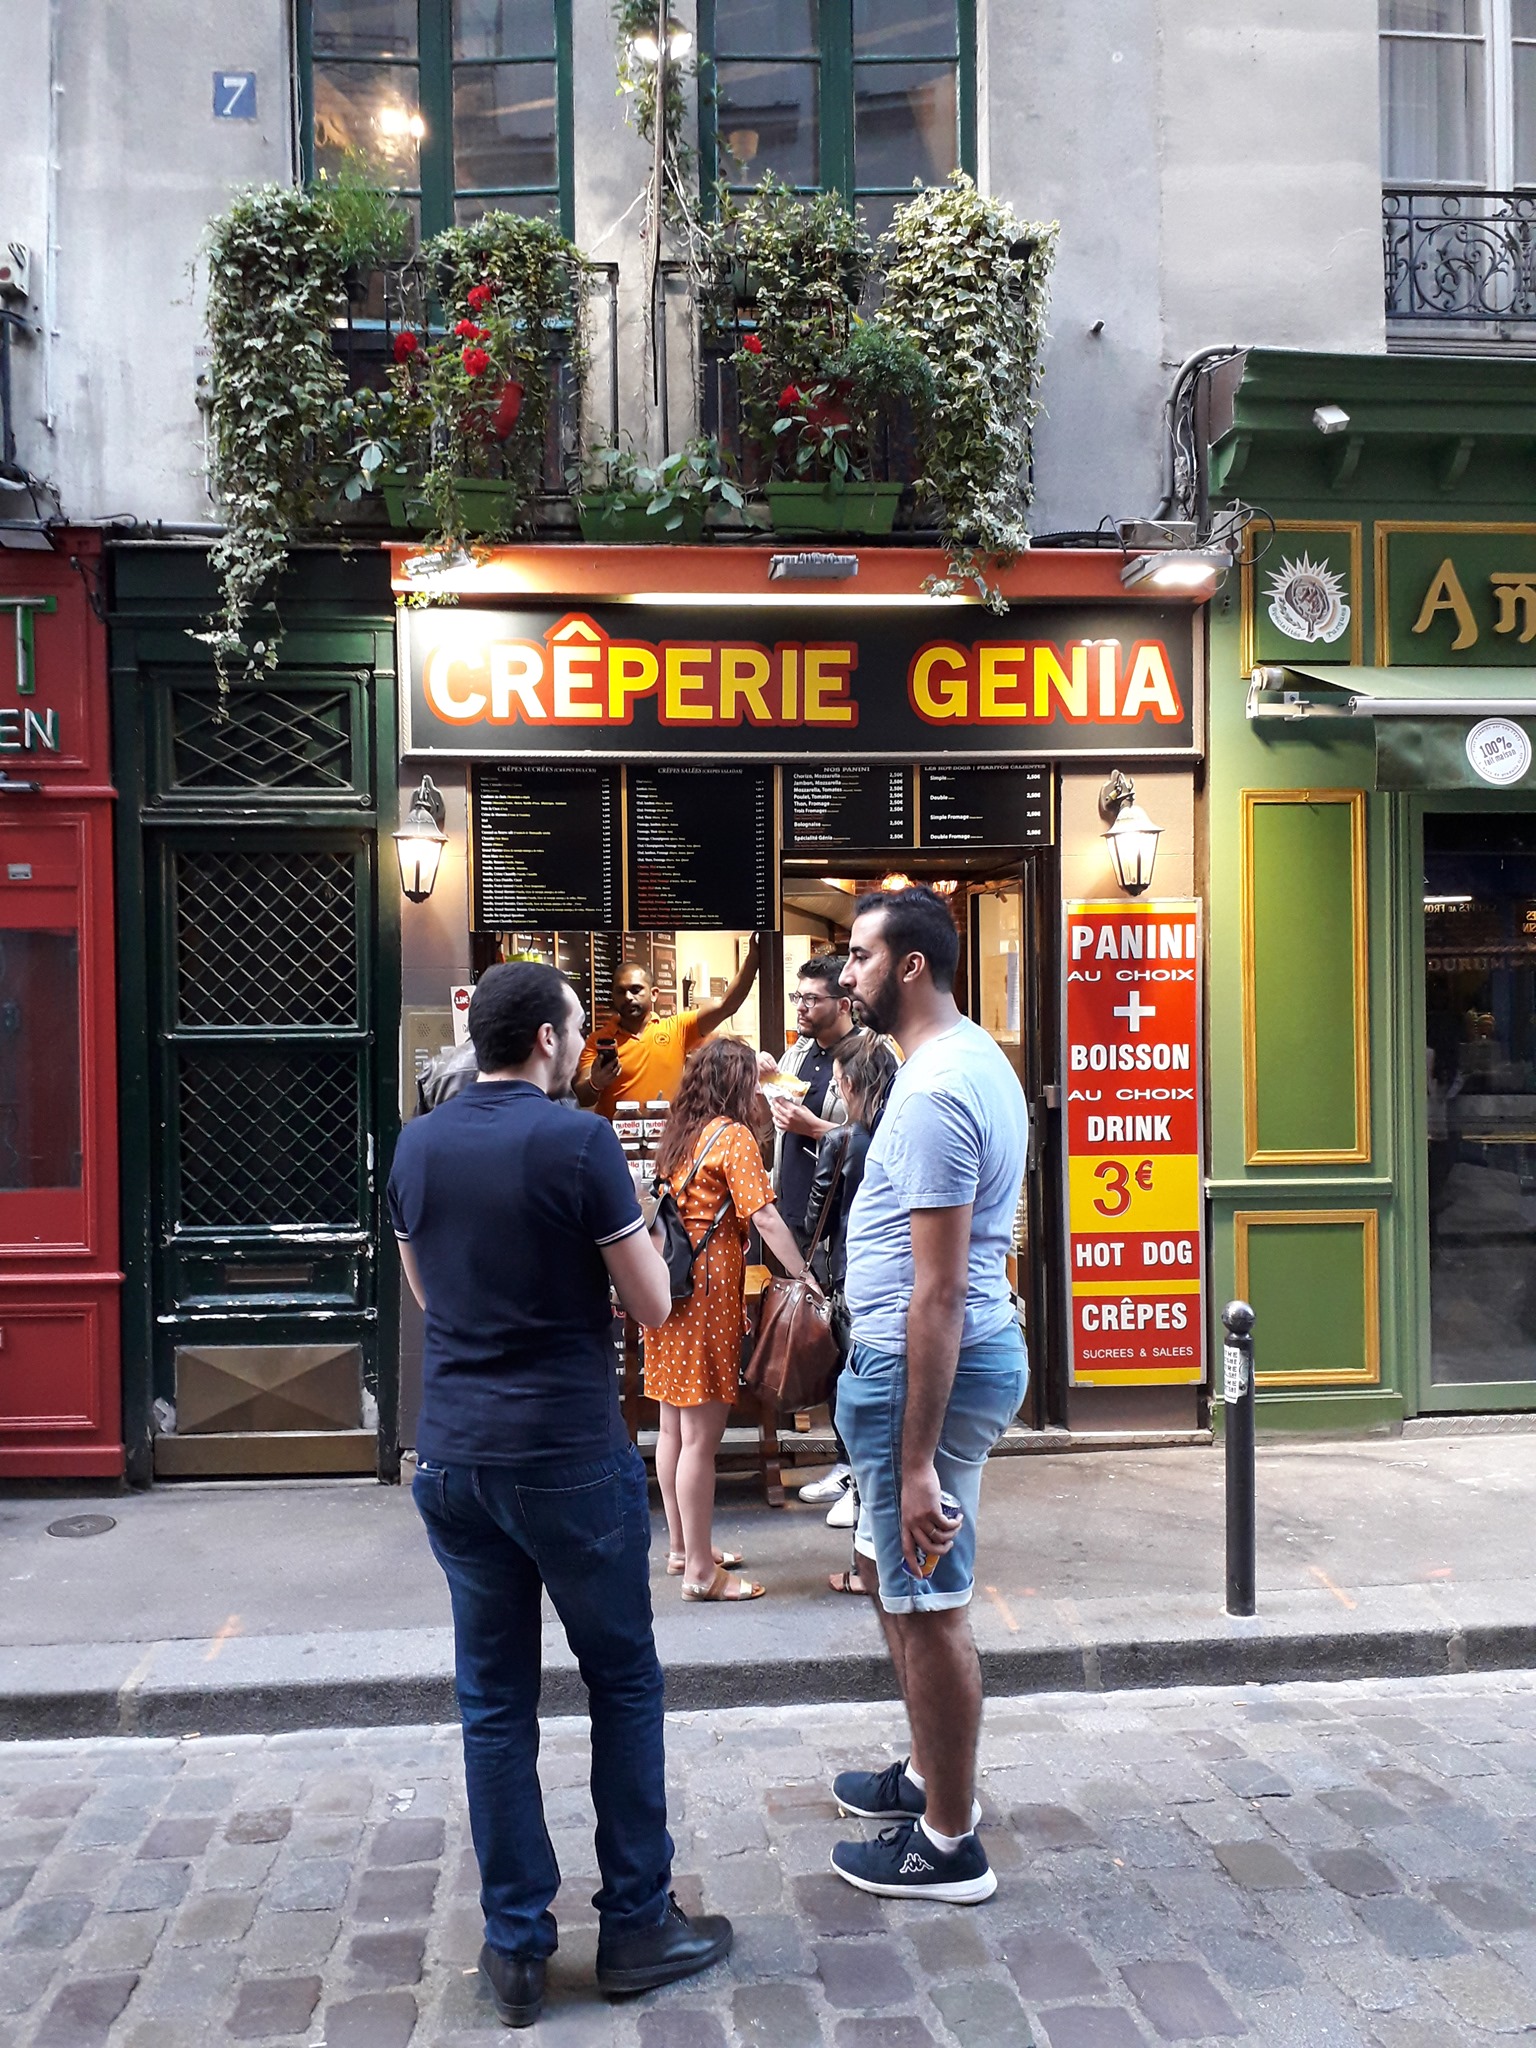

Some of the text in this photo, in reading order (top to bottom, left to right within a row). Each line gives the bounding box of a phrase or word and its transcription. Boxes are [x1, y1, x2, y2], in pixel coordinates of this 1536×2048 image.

[223, 76, 248, 115] 7
[425, 615, 1182, 725] CRÊPERIE GENIA
[1479, 736, 1513, 758] 100%
[1495, 749, 1517, 762] maison
[1072, 924, 1195, 960] PANINI
[1067, 969, 1194, 982] AU CHOIX
[1071, 1043, 1190, 1071] BOISSON
[1067, 1088, 1194, 1101] AU CHOIX
[615, 1120, 640, 1129] nutella
[1088, 1115, 1172, 1142] DRINK
[1076, 1240, 1193, 1267] HOT DOG
[1082, 1297, 1187, 1331] CRÊPES
[1083, 1346, 1194, 1359] SUCREES & SALEES
